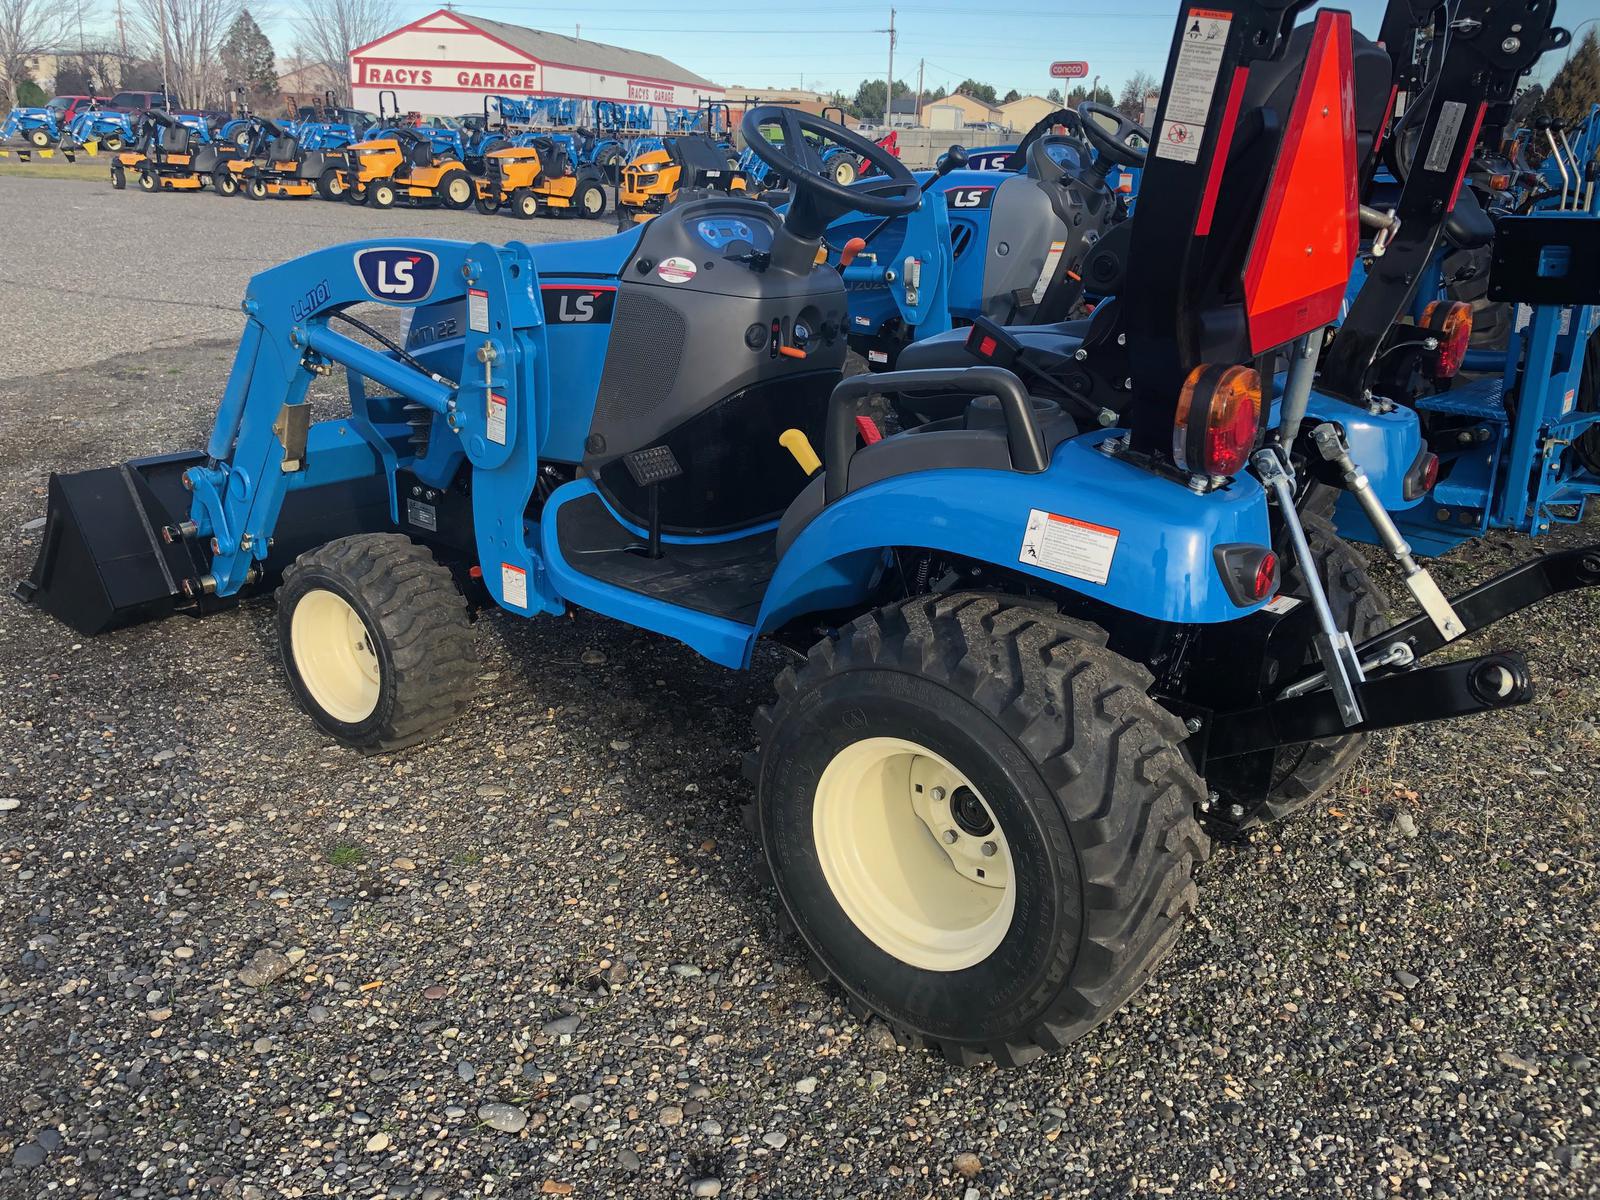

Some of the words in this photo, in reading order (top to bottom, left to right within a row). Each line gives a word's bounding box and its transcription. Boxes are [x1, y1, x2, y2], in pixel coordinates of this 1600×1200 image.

[457, 72, 535, 89] GARAGE
[654, 89, 674, 103] GARAGE
[980, 157, 1005, 171] LS
[954, 191, 982, 207] LS
[378, 260, 414, 294] LS
[292, 279, 332, 322] LL1101
[559, 295, 594, 322] LS
